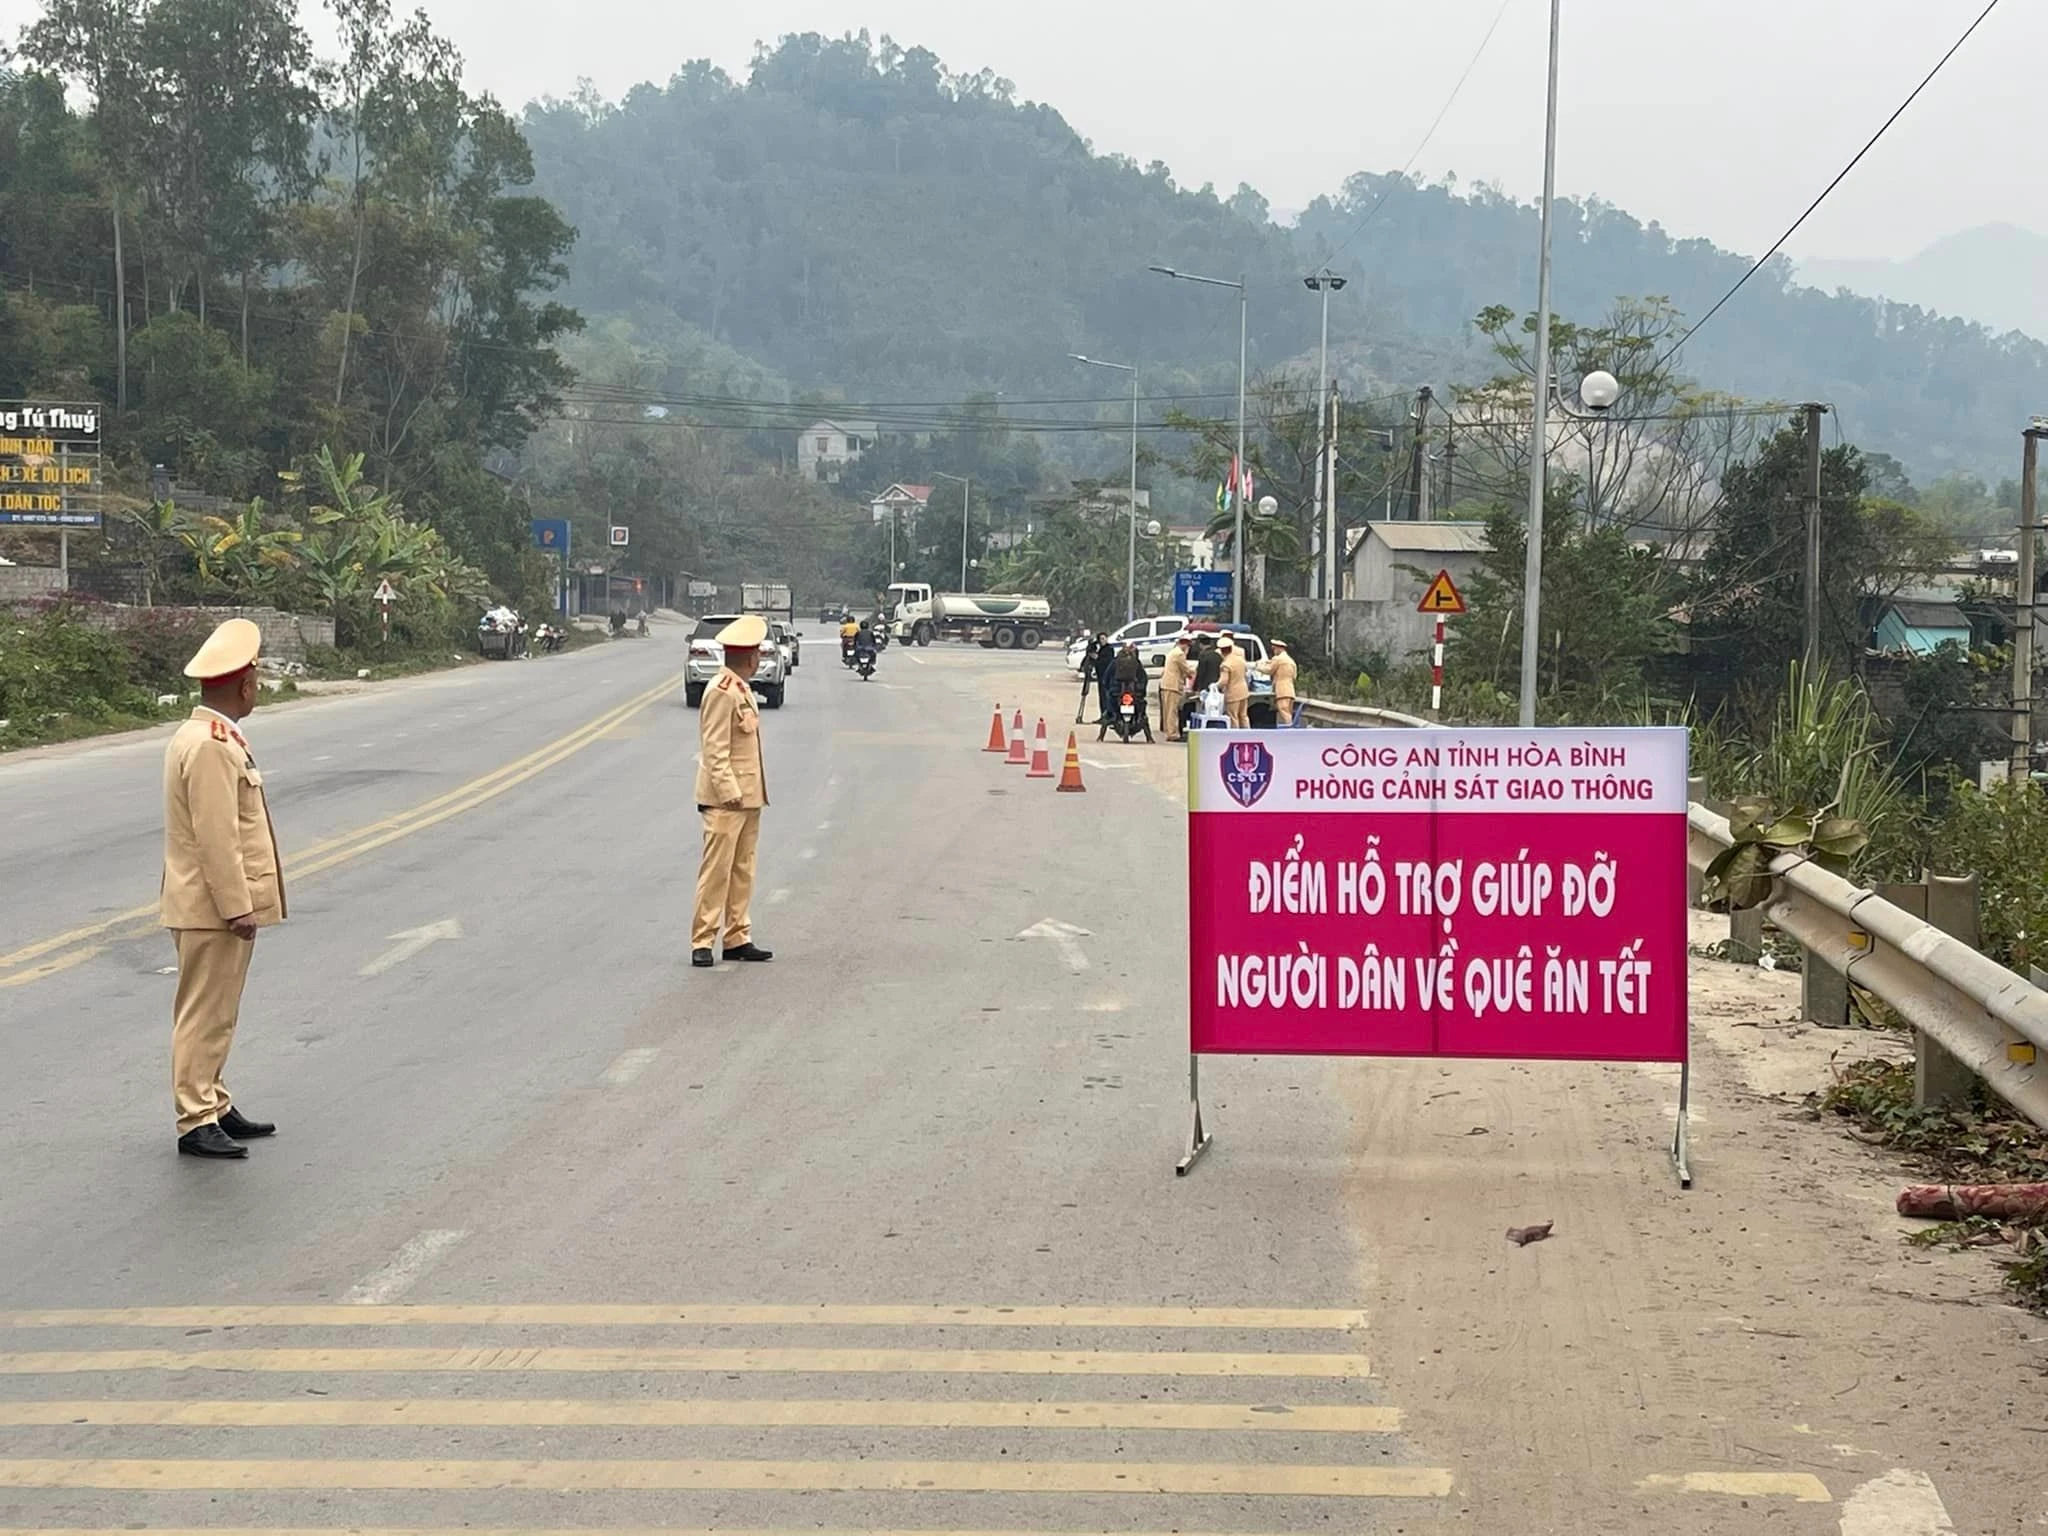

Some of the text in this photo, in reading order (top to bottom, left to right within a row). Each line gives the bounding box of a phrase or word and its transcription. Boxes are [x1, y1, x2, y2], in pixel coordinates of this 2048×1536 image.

[22, 407, 44, 428] Tú
[1321, 740, 1626, 767] CÔNG AN TỈNH HÒA BÌNH
[1295, 770, 1654, 800] PHÒNG CẢNH SÁT GIAO THÔNG
[1248, 833, 1617, 934] ĐIỂM HỖ TRỢ GIÚP ĐỠ
[1217, 937, 1652, 1018] NGƯỜI DÂN VỀ QUÊ ĂN TẾT
